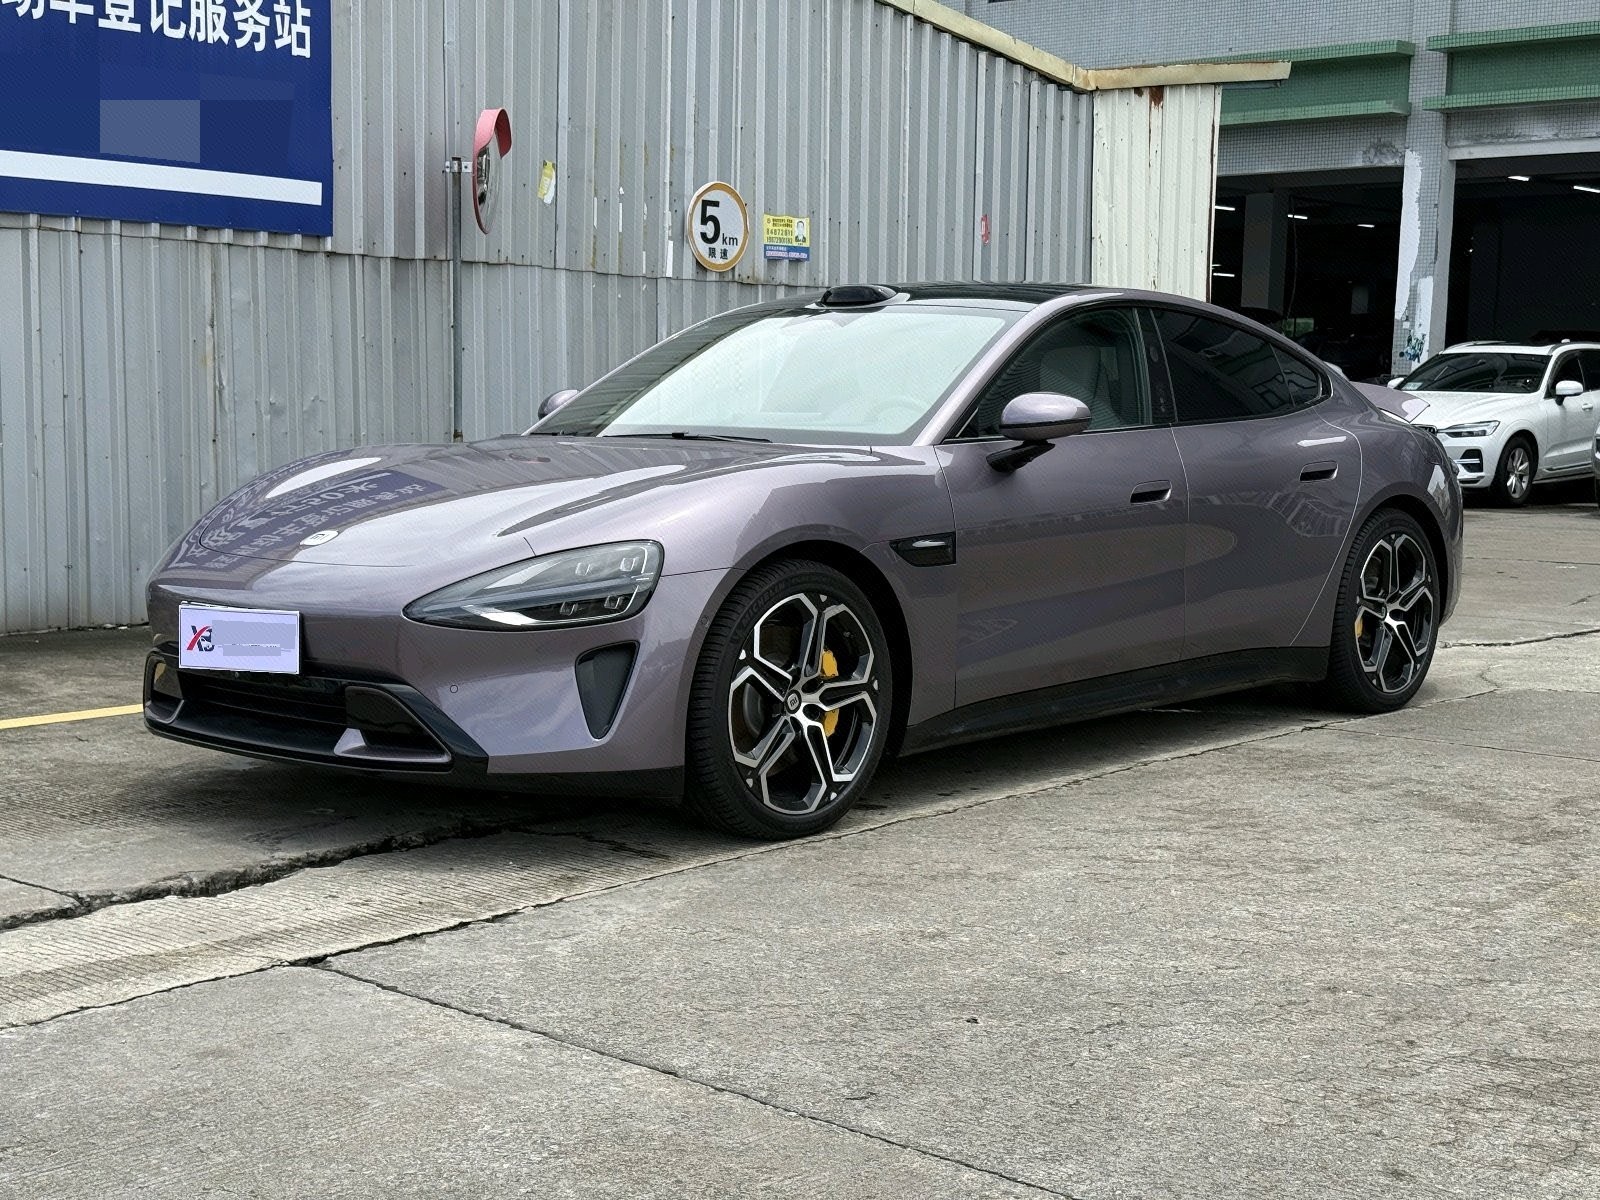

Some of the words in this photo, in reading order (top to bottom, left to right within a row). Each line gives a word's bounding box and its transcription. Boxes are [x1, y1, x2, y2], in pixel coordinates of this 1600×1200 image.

[700, 199, 720, 244] 5
[722, 233, 738, 246] km
[708, 247, 728, 260] 限速
